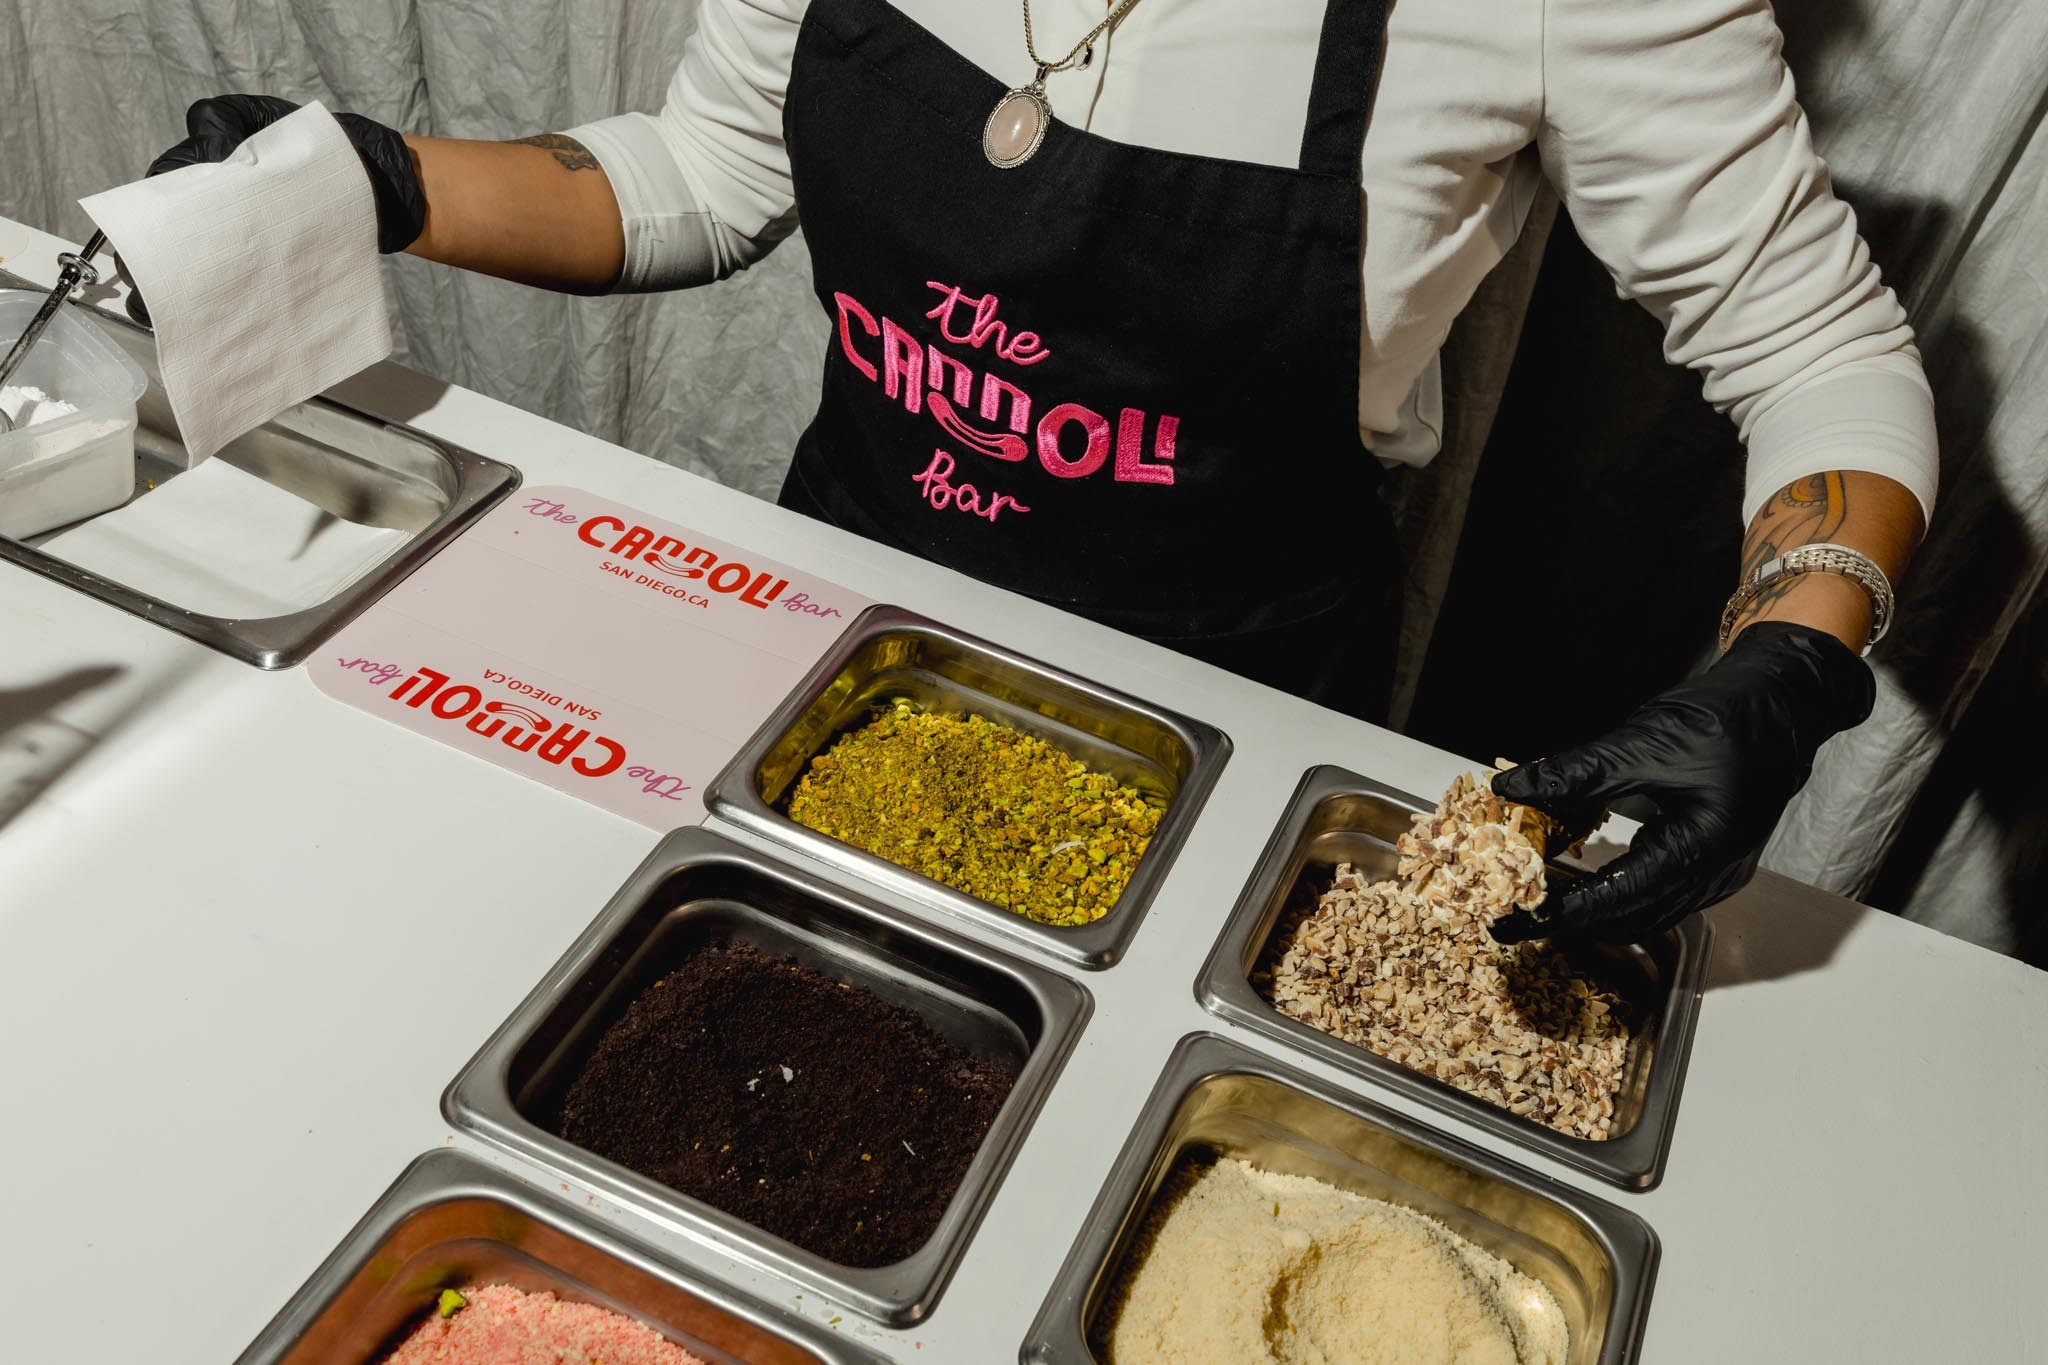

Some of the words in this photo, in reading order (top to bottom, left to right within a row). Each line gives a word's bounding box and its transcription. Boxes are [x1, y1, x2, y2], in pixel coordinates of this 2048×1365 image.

[926, 281, 1050, 365] the
[912, 448, 1031, 522] Bar
[522, 498, 578, 525] the
[781, 592, 843, 620] Bar
[599, 561, 634, 579] SAN
[563, 701, 602, 720] SAN
[627, 765, 691, 801] the
